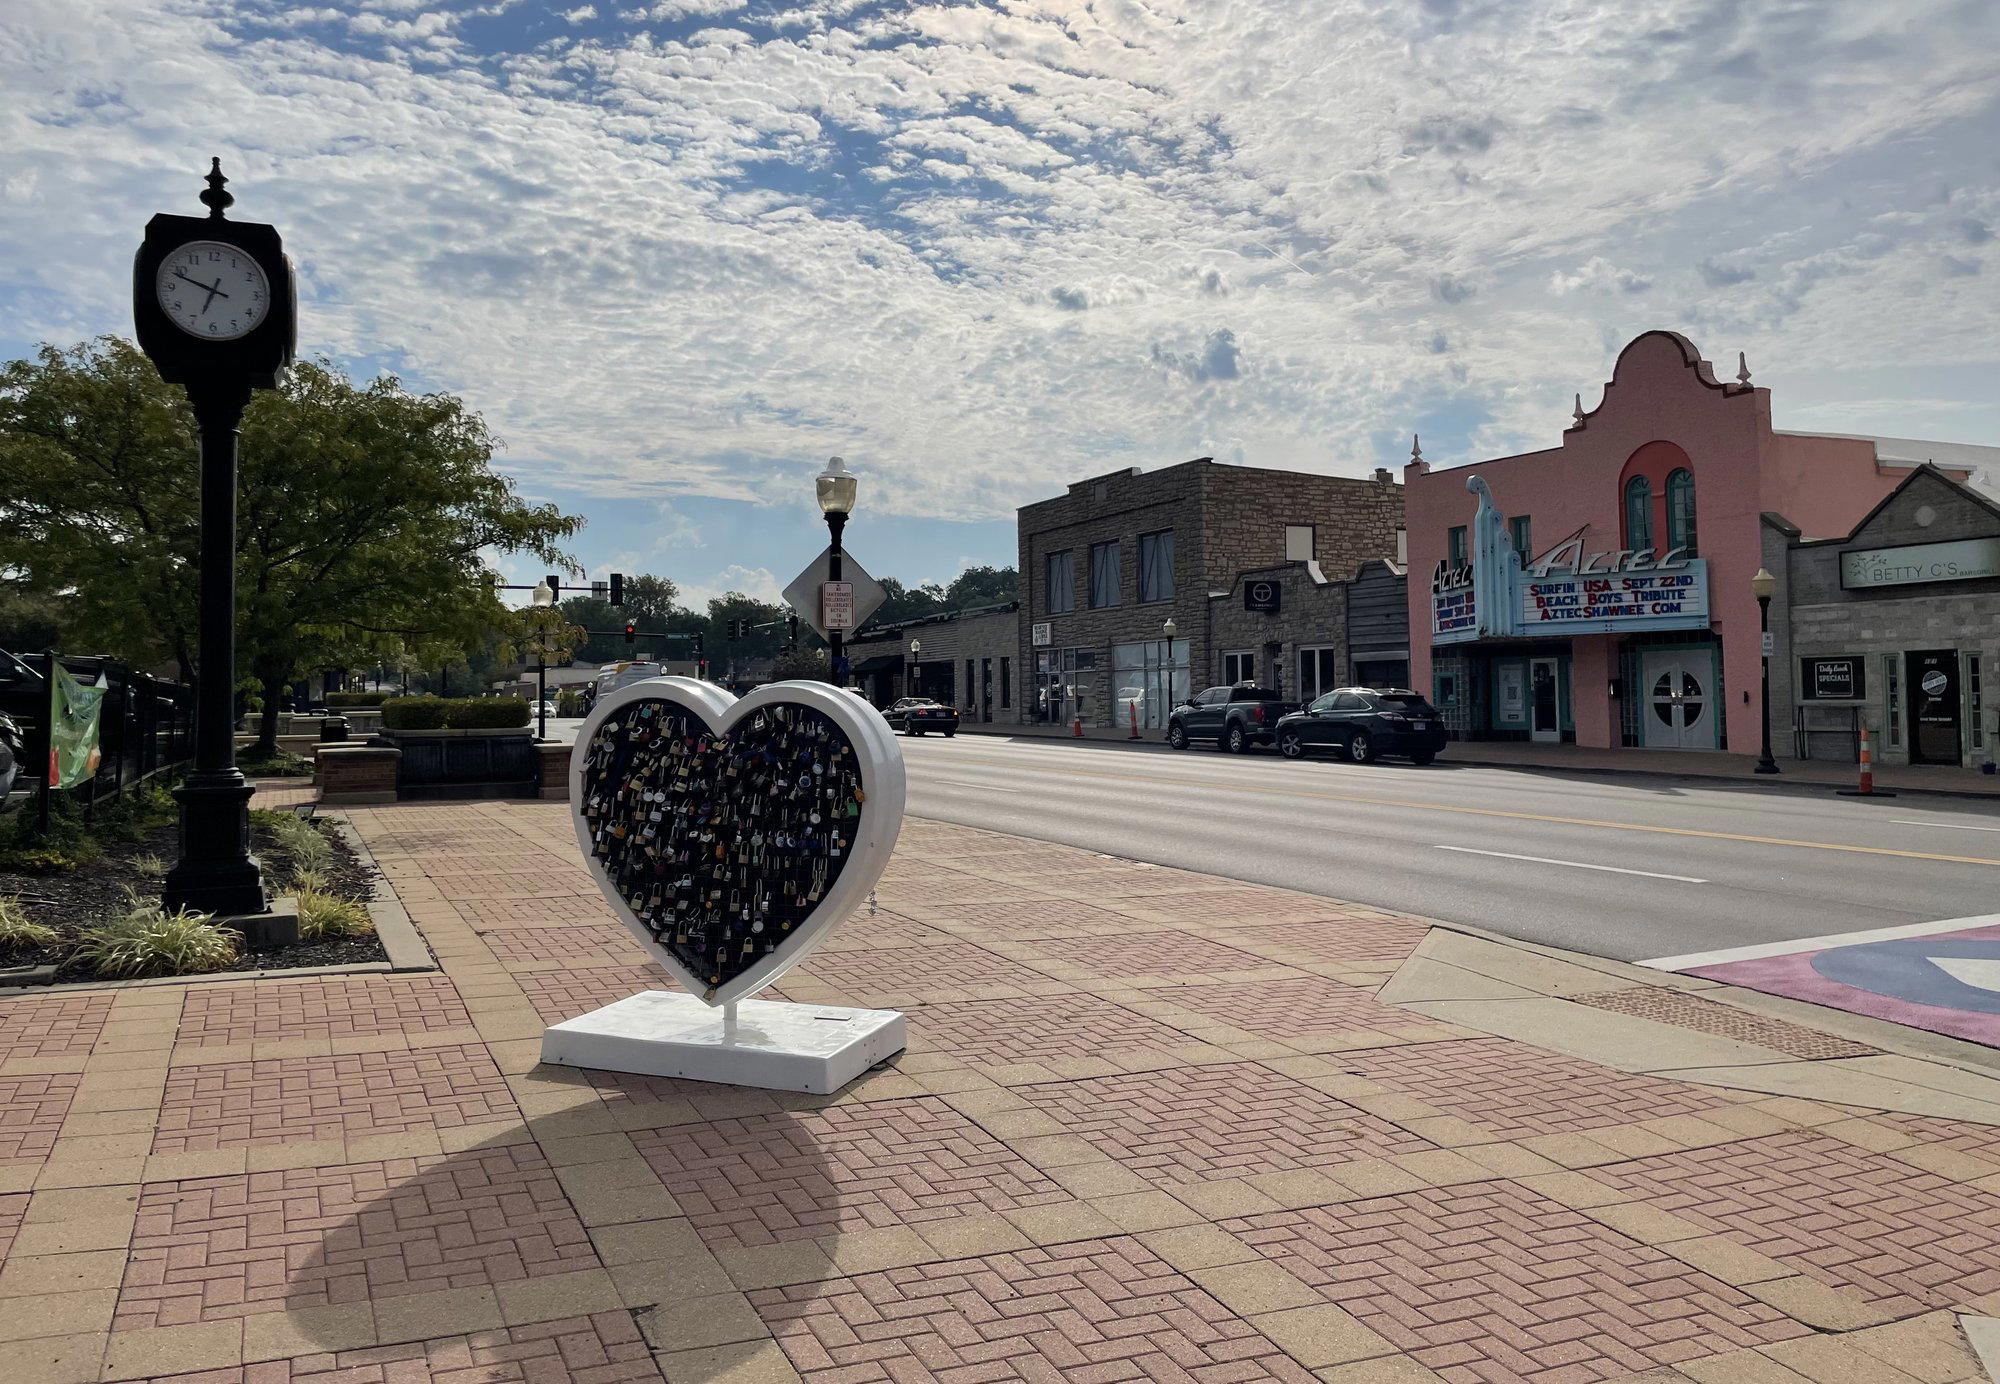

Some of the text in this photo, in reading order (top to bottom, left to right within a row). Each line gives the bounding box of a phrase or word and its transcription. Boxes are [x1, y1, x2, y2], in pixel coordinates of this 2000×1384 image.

[189, 255, 200, 265] 11
[208, 251, 221, 262] 12
[231, 258, 237, 269] 1
[175, 265, 188, 278] 10
[245, 271, 256, 282] 2
[167, 282, 176, 292] 9
[252, 290, 259, 301] 3
[174, 300, 182, 310] 8
[244, 308, 253, 318] 4
[208, 321, 218, 333] 6
[230, 319, 238, 330] 5
[1873, 562, 1958, 582] BETTY C'S
[1530, 575, 1694, 597] SURFIN USA SEPT 22ND
[1536, 588, 1687, 609] BEACH BOYS TRIBUTE
[1651, 601, 1682, 615] COM
[1818, 674, 1850, 682] SPECIALS
